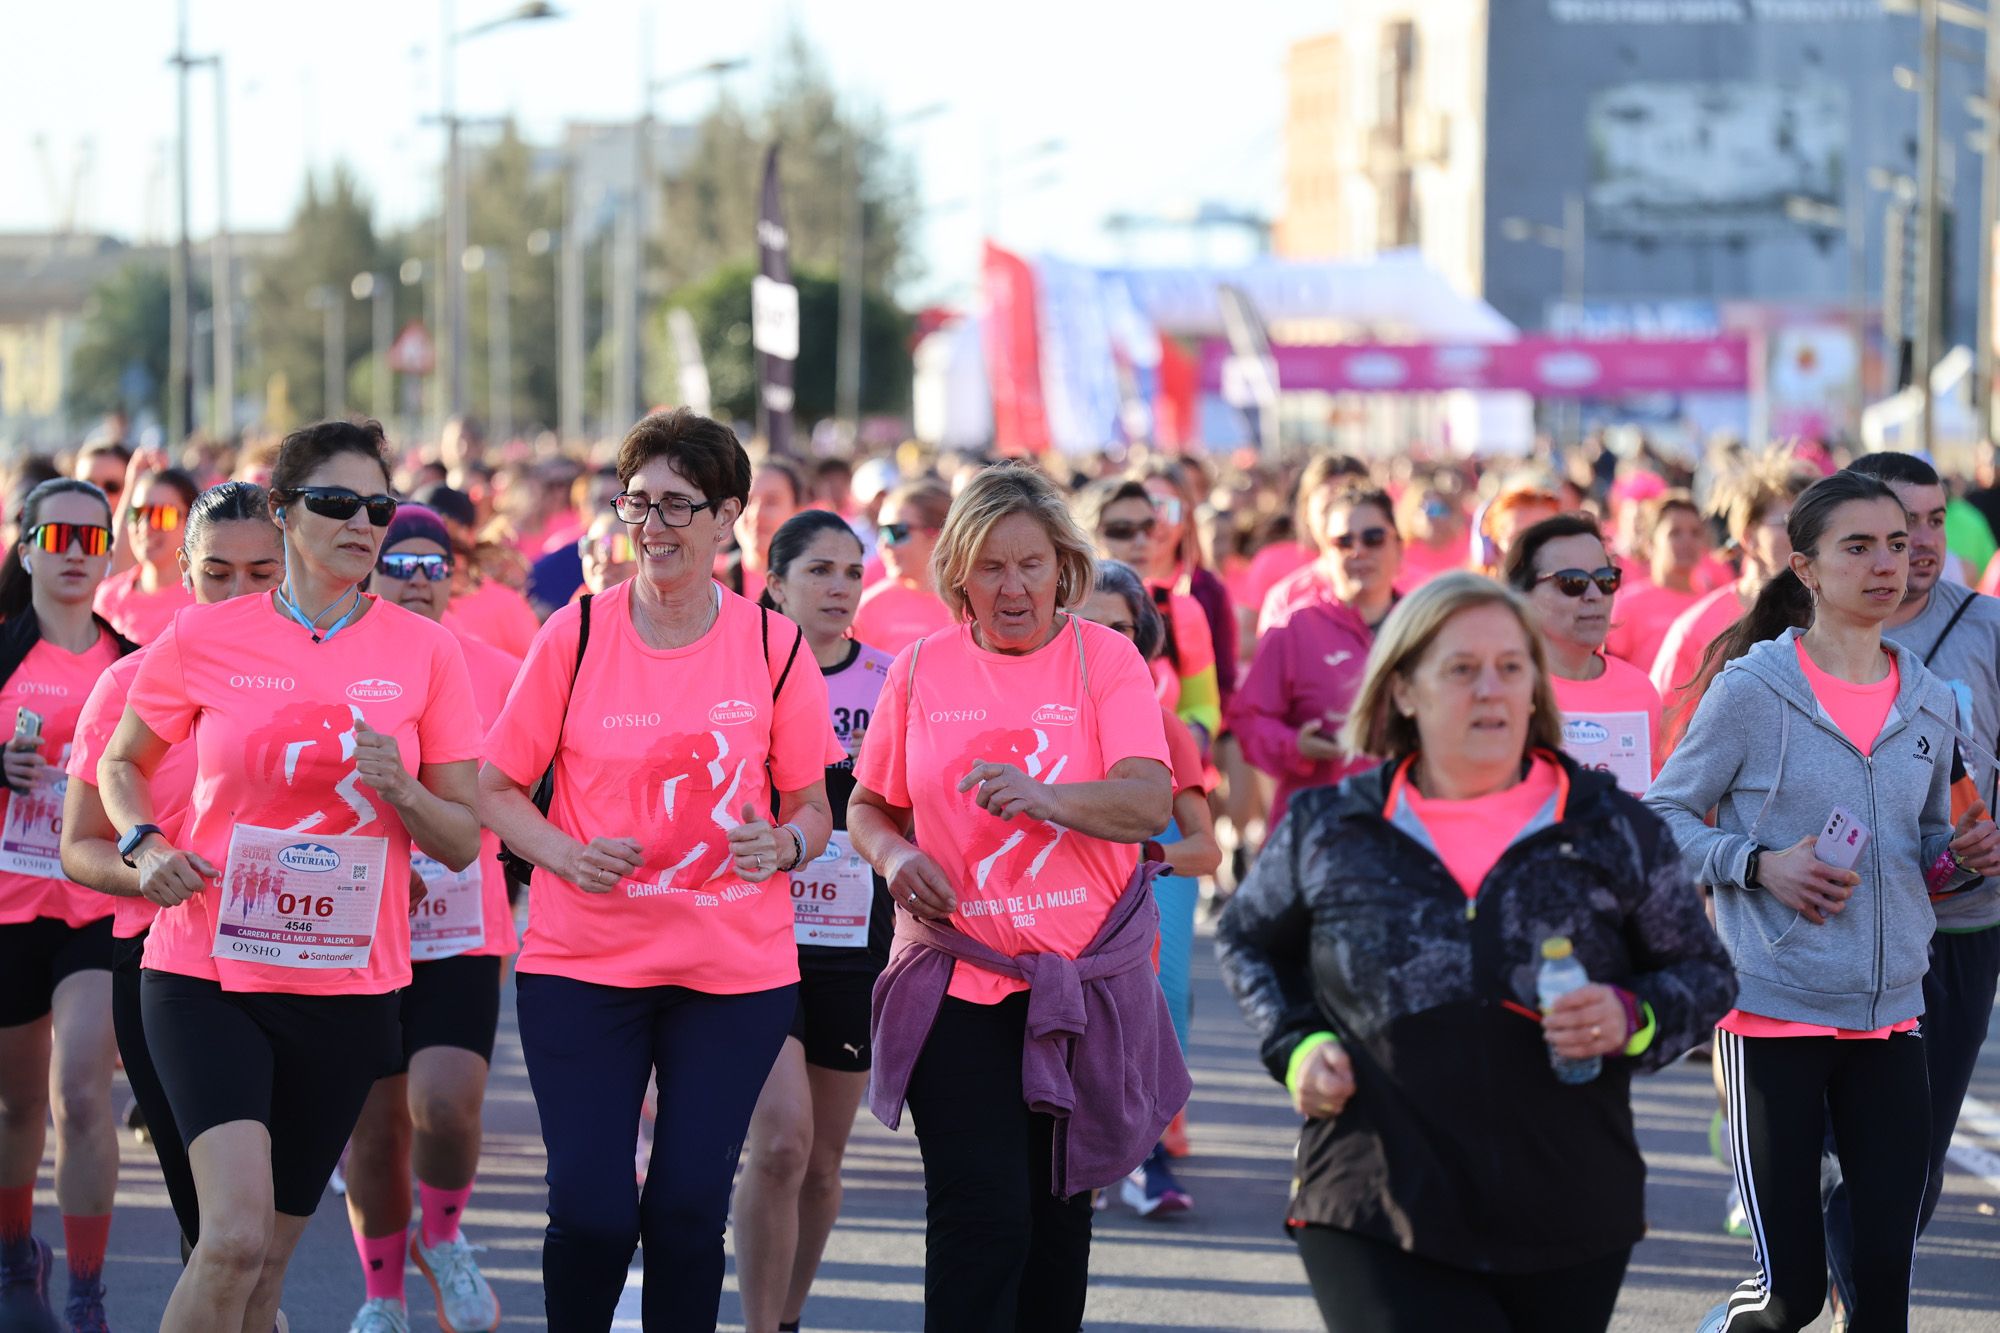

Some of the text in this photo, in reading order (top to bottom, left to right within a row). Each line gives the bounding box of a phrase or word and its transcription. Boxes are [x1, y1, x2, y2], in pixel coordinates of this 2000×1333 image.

[17, 681, 68, 697] OYSHO
[230, 675, 295, 692] OYSHO
[350, 685, 398, 697] ASTURIANA
[603, 713, 660, 729] OYSHO
[711, 709, 753, 721] ASTURIANA
[930, 709, 986, 723] OYSHO
[1036, 711, 1074, 722] ASTURIAN
[12, 855, 53, 871] OYSHO
[242, 849, 271, 862] SUMA
[282, 850, 337, 868] ASTURIANA
[720, 883, 762, 903] MUJER
[790, 880, 837, 901] 016
[277, 893, 334, 917] 016
[695, 895, 719, 906] 2025
[1008, 896, 1024, 913] DE
[1027, 894, 1044, 911] LA
[1046, 887, 1088, 908] MUJER
[796, 903, 820, 914] 6334
[285, 920, 312, 932] 4546
[1012, 914, 1035, 928] 2025
[237, 928, 354, 945] CARRERA DE LA MUJER VALENCIA
[819, 930, 854, 940] Santander
[232, 942, 281, 958] OYSHO
[310, 952, 354, 962] Santander
